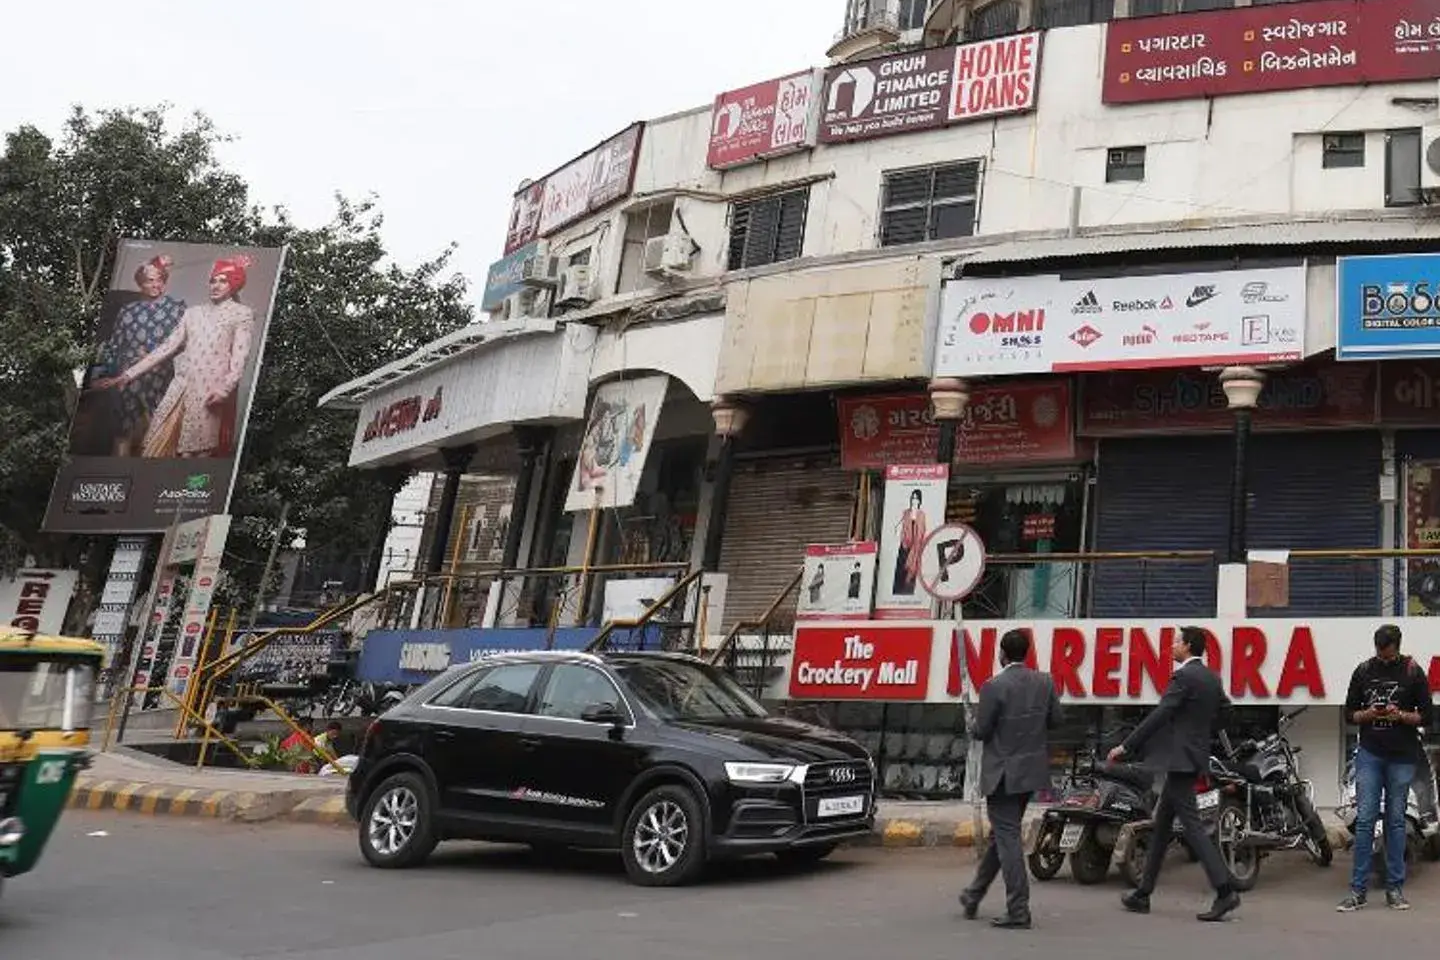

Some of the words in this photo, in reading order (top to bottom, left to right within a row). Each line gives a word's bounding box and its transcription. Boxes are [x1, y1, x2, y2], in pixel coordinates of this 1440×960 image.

[1262, 19, 1347, 41] સ્વરોજગાર
[1395, 20, 1422, 39] હોમ
[1138, 33, 1206, 53] પગારદાર
[880, 55, 926, 76] GRUH
[959, 36, 1035, 81] HOME
[1136, 57, 1228, 82] વ્યાવસાયિક
[1260, 45, 1357, 72] બિઝનેસમેન
[877, 70, 949, 96] FINANCE
[954, 72, 1030, 116] LOANS
[873, 90, 941, 114] LIMITED
[1113, 299, 1159, 312] Reebok
[969, 308, 1045, 334] OMNI
[1365, 319, 1401, 328] DIGITAL
[1402, 318, 1434, 327] COLOR
[936, 539, 965, 583] P
[845, 635, 874, 660] The
[798, 660, 874, 691] Crockery
[877, 660, 919, 685] Mall
